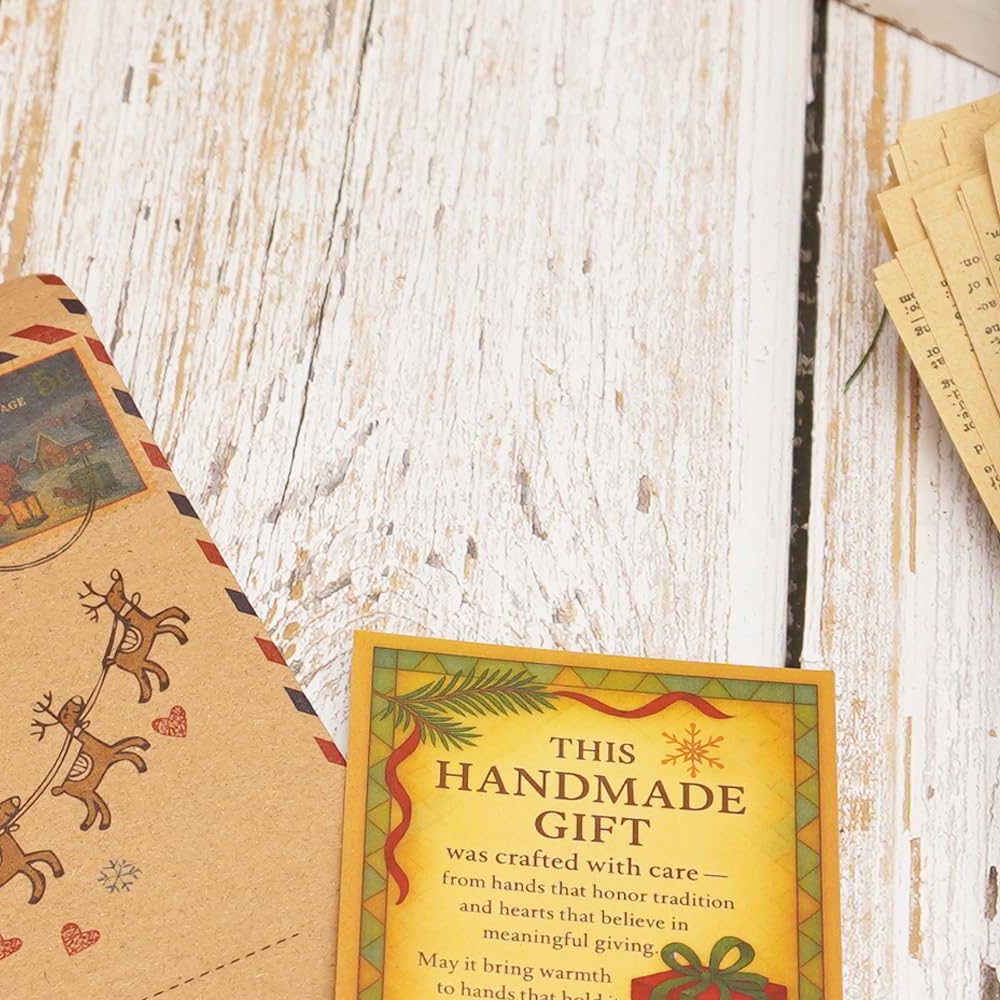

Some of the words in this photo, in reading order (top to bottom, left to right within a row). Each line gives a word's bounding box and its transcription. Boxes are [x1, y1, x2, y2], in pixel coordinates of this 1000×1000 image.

[549, 736, 636, 765] THIS
[434, 760, 747, 816] HANDMADE
[534, 810, 651, 847] GIFT
[446, 846, 489, 864] was
[496, 848, 578, 872] crafted
[586, 857, 641, 876] with
[442, 870, 486, 889] from
[492, 874, 545, 895] hands
[551, 881, 587, 898] that
[592, 884, 648, 903] honor
[653, 890, 735, 910] tradition
[459, 899, 493, 915] and
[499, 901, 554, 920] hearts
[560, 907, 595, 924] that
[601, 910, 665, 930] believe
[672, 917, 689, 932] in
[483, 927, 588, 950] meaningful
[595, 935, 660, 957] giving.
[418, 951, 459, 974] May
[464, 956, 477, 972] it
[483, 957, 534, 982] bring
[540, 966, 612, 984] warmth
[437, 981, 455, 996] to
[460, 980, 515, 1000] hands
